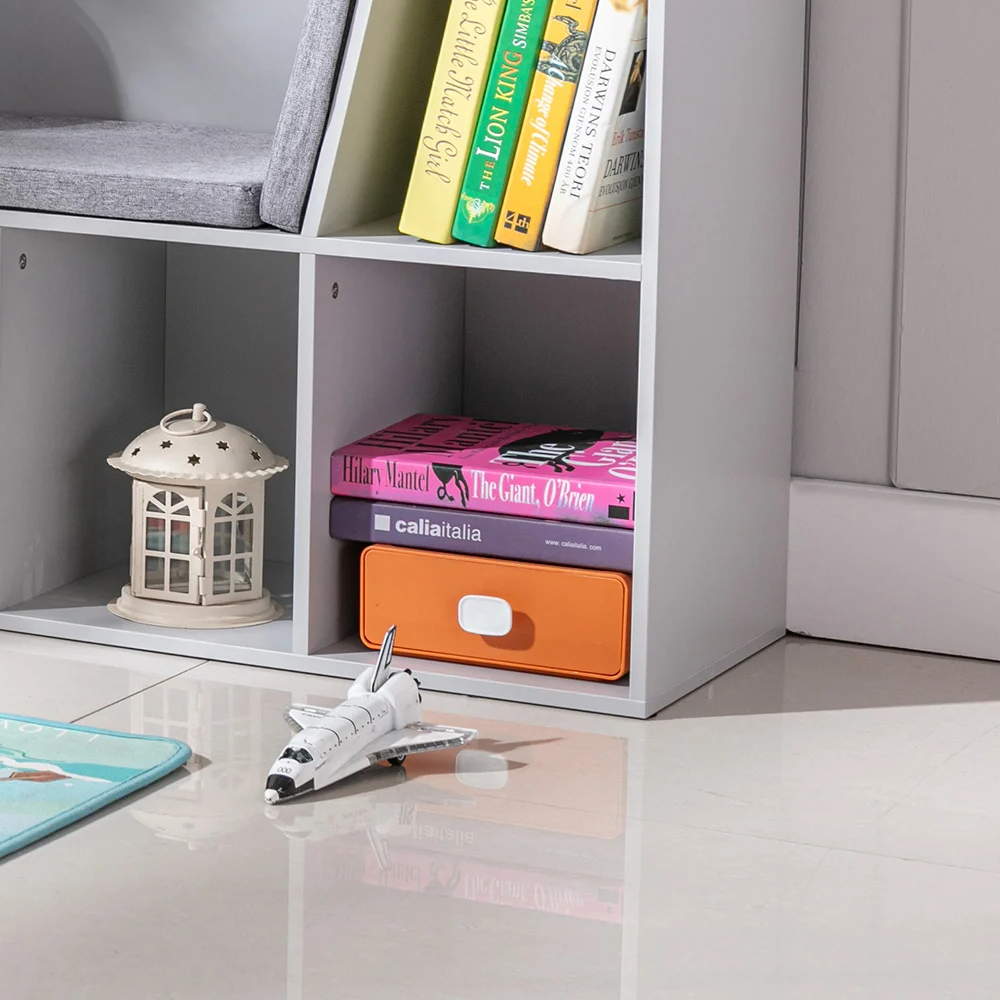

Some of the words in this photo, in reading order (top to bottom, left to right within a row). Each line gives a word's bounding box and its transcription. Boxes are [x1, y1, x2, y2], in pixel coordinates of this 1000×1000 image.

[450, 11, 487, 68] Little
[494, 50, 523, 103] KING
[533, 67, 566, 118] Change
[582, 45, 602, 105] EVOLUSJON
[584, 48, 617, 138] DARWINS
[435, 69, 475, 139] Match
[530, 116, 551, 136] of
[476, 105, 510, 161] LION
[569, 107, 587, 158] GJENNOM
[422, 135, 459, 184] Girl
[479, 160, 496, 191] THE
[520, 132, 552, 187] Climate
[570, 142, 594, 199] TEORI
[356, 417, 463, 450] Hilary
[403, 417, 521, 458] Mantel
[489, 443, 576, 467] The
[562, 437, 636, 467] Gian
[342, 454, 383, 495] Hilary
[385, 460, 430, 492] Mantel
[470, 469, 497, 502] The
[499, 472, 541, 509] Giant,
[544, 477, 596, 512] O'Brien
[395, 516, 482, 543] caliaitalia
